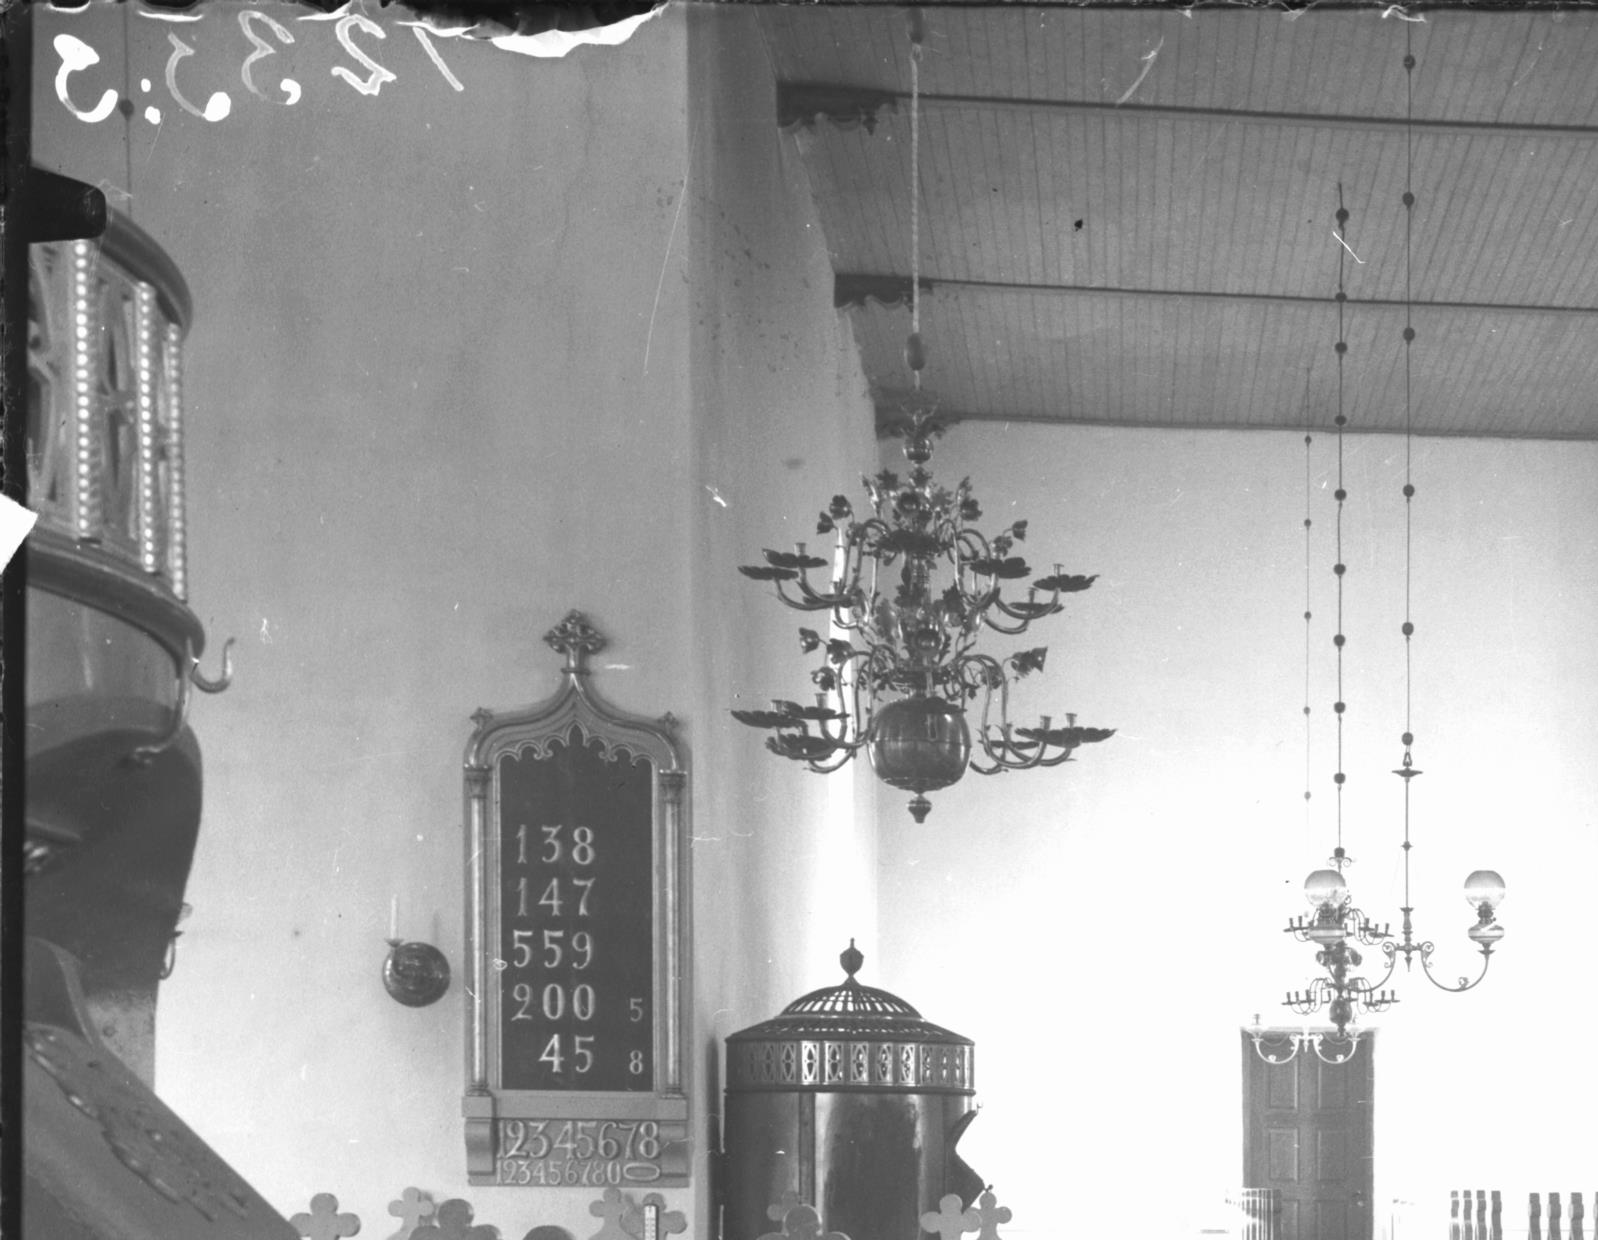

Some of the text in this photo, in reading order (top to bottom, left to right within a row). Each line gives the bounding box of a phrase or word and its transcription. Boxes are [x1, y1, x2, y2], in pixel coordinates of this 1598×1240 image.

[515, 823, 597, 865] 138
[515, 876, 597, 918] 147
[511, 929, 595, 971] 559
[510, 982, 645, 1023] 200 5
[537, 1032, 645, 1076] 45 8
